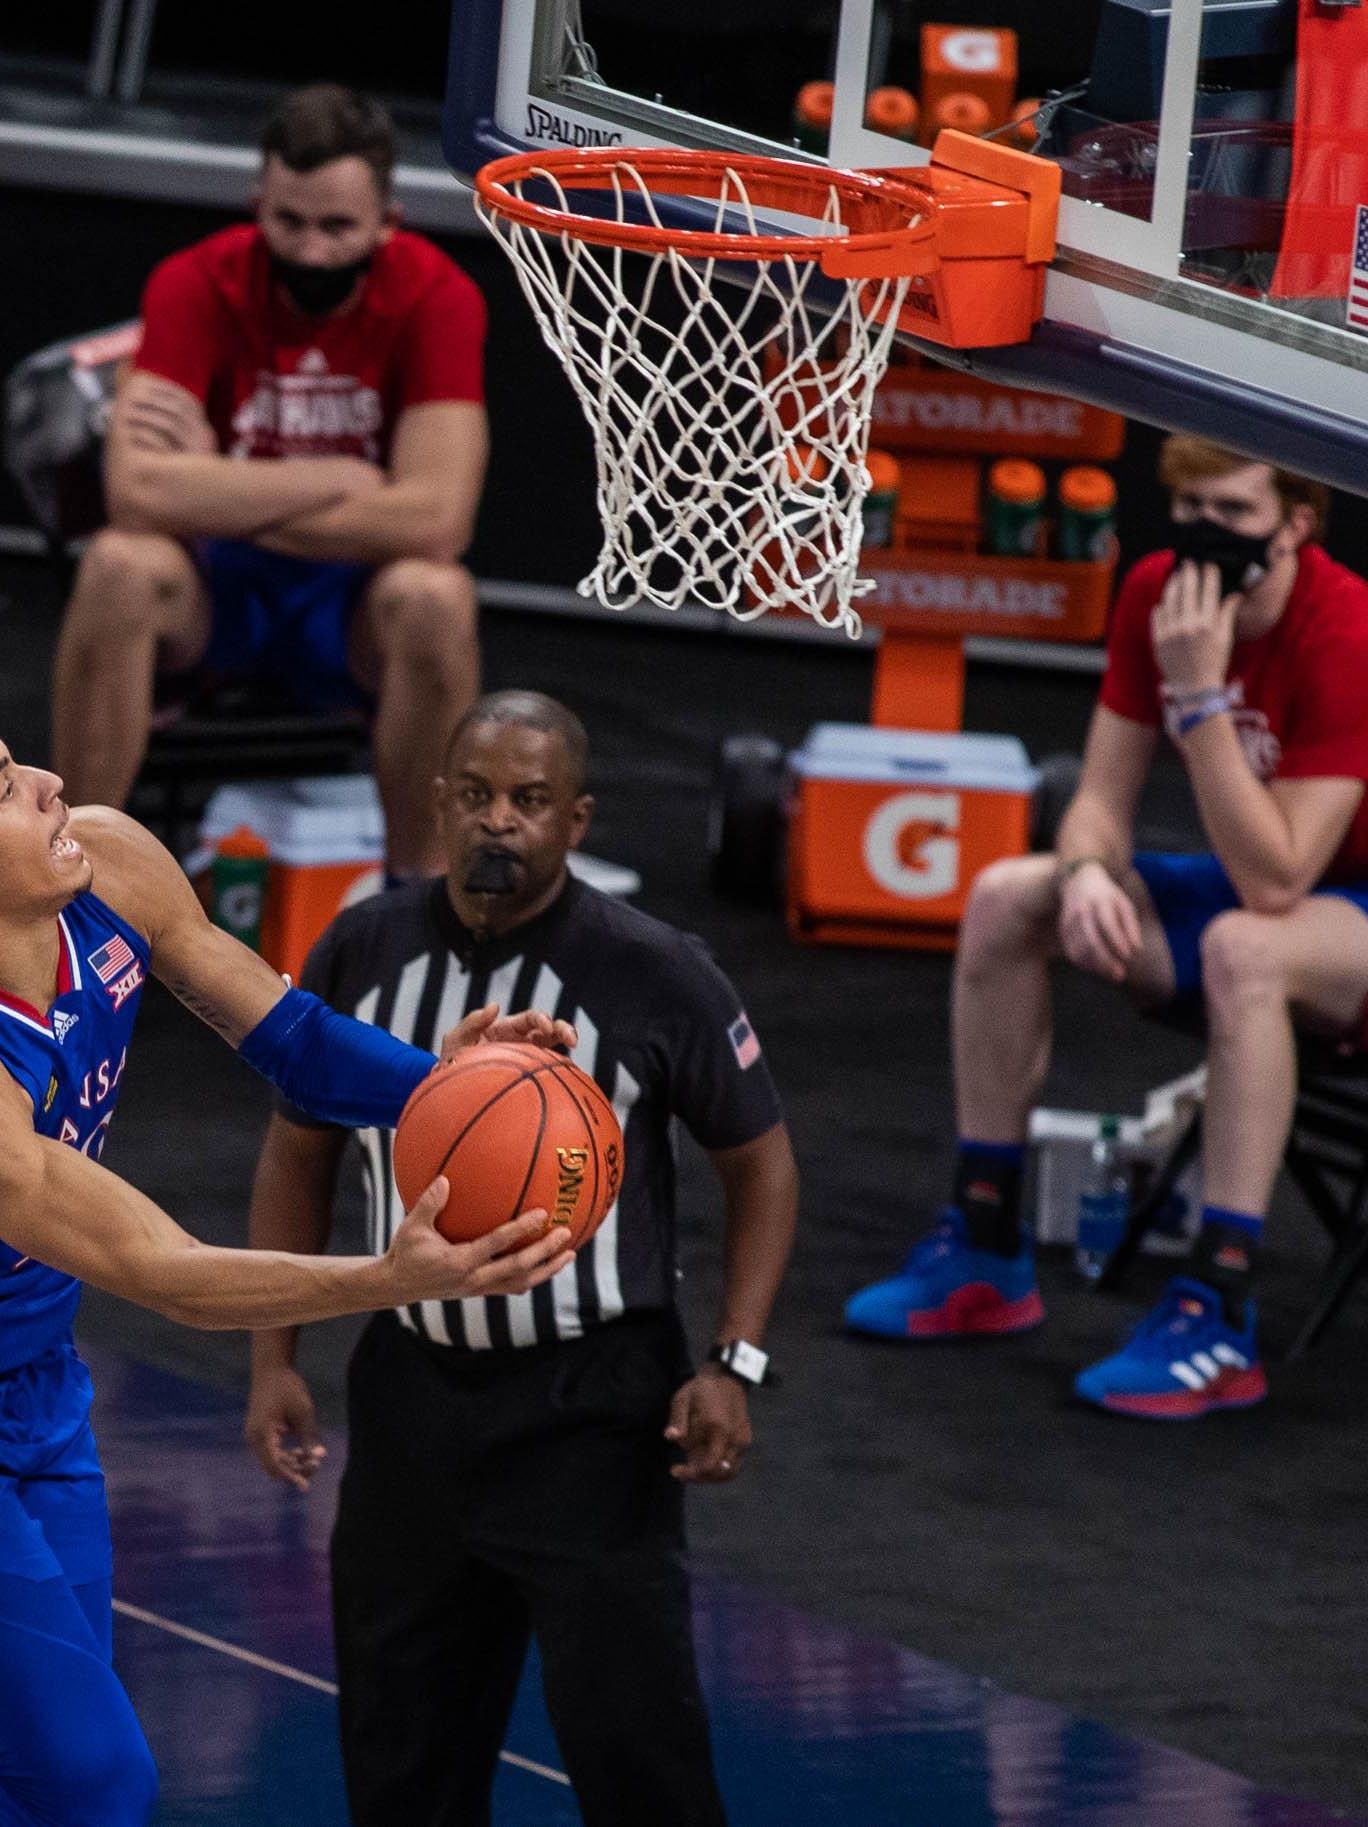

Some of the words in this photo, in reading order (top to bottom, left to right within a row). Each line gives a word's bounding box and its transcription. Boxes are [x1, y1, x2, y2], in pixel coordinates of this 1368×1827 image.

[941, 30, 999, 73] G
[863, 791, 960, 899] G
[550, 1147, 589, 1227] DING
